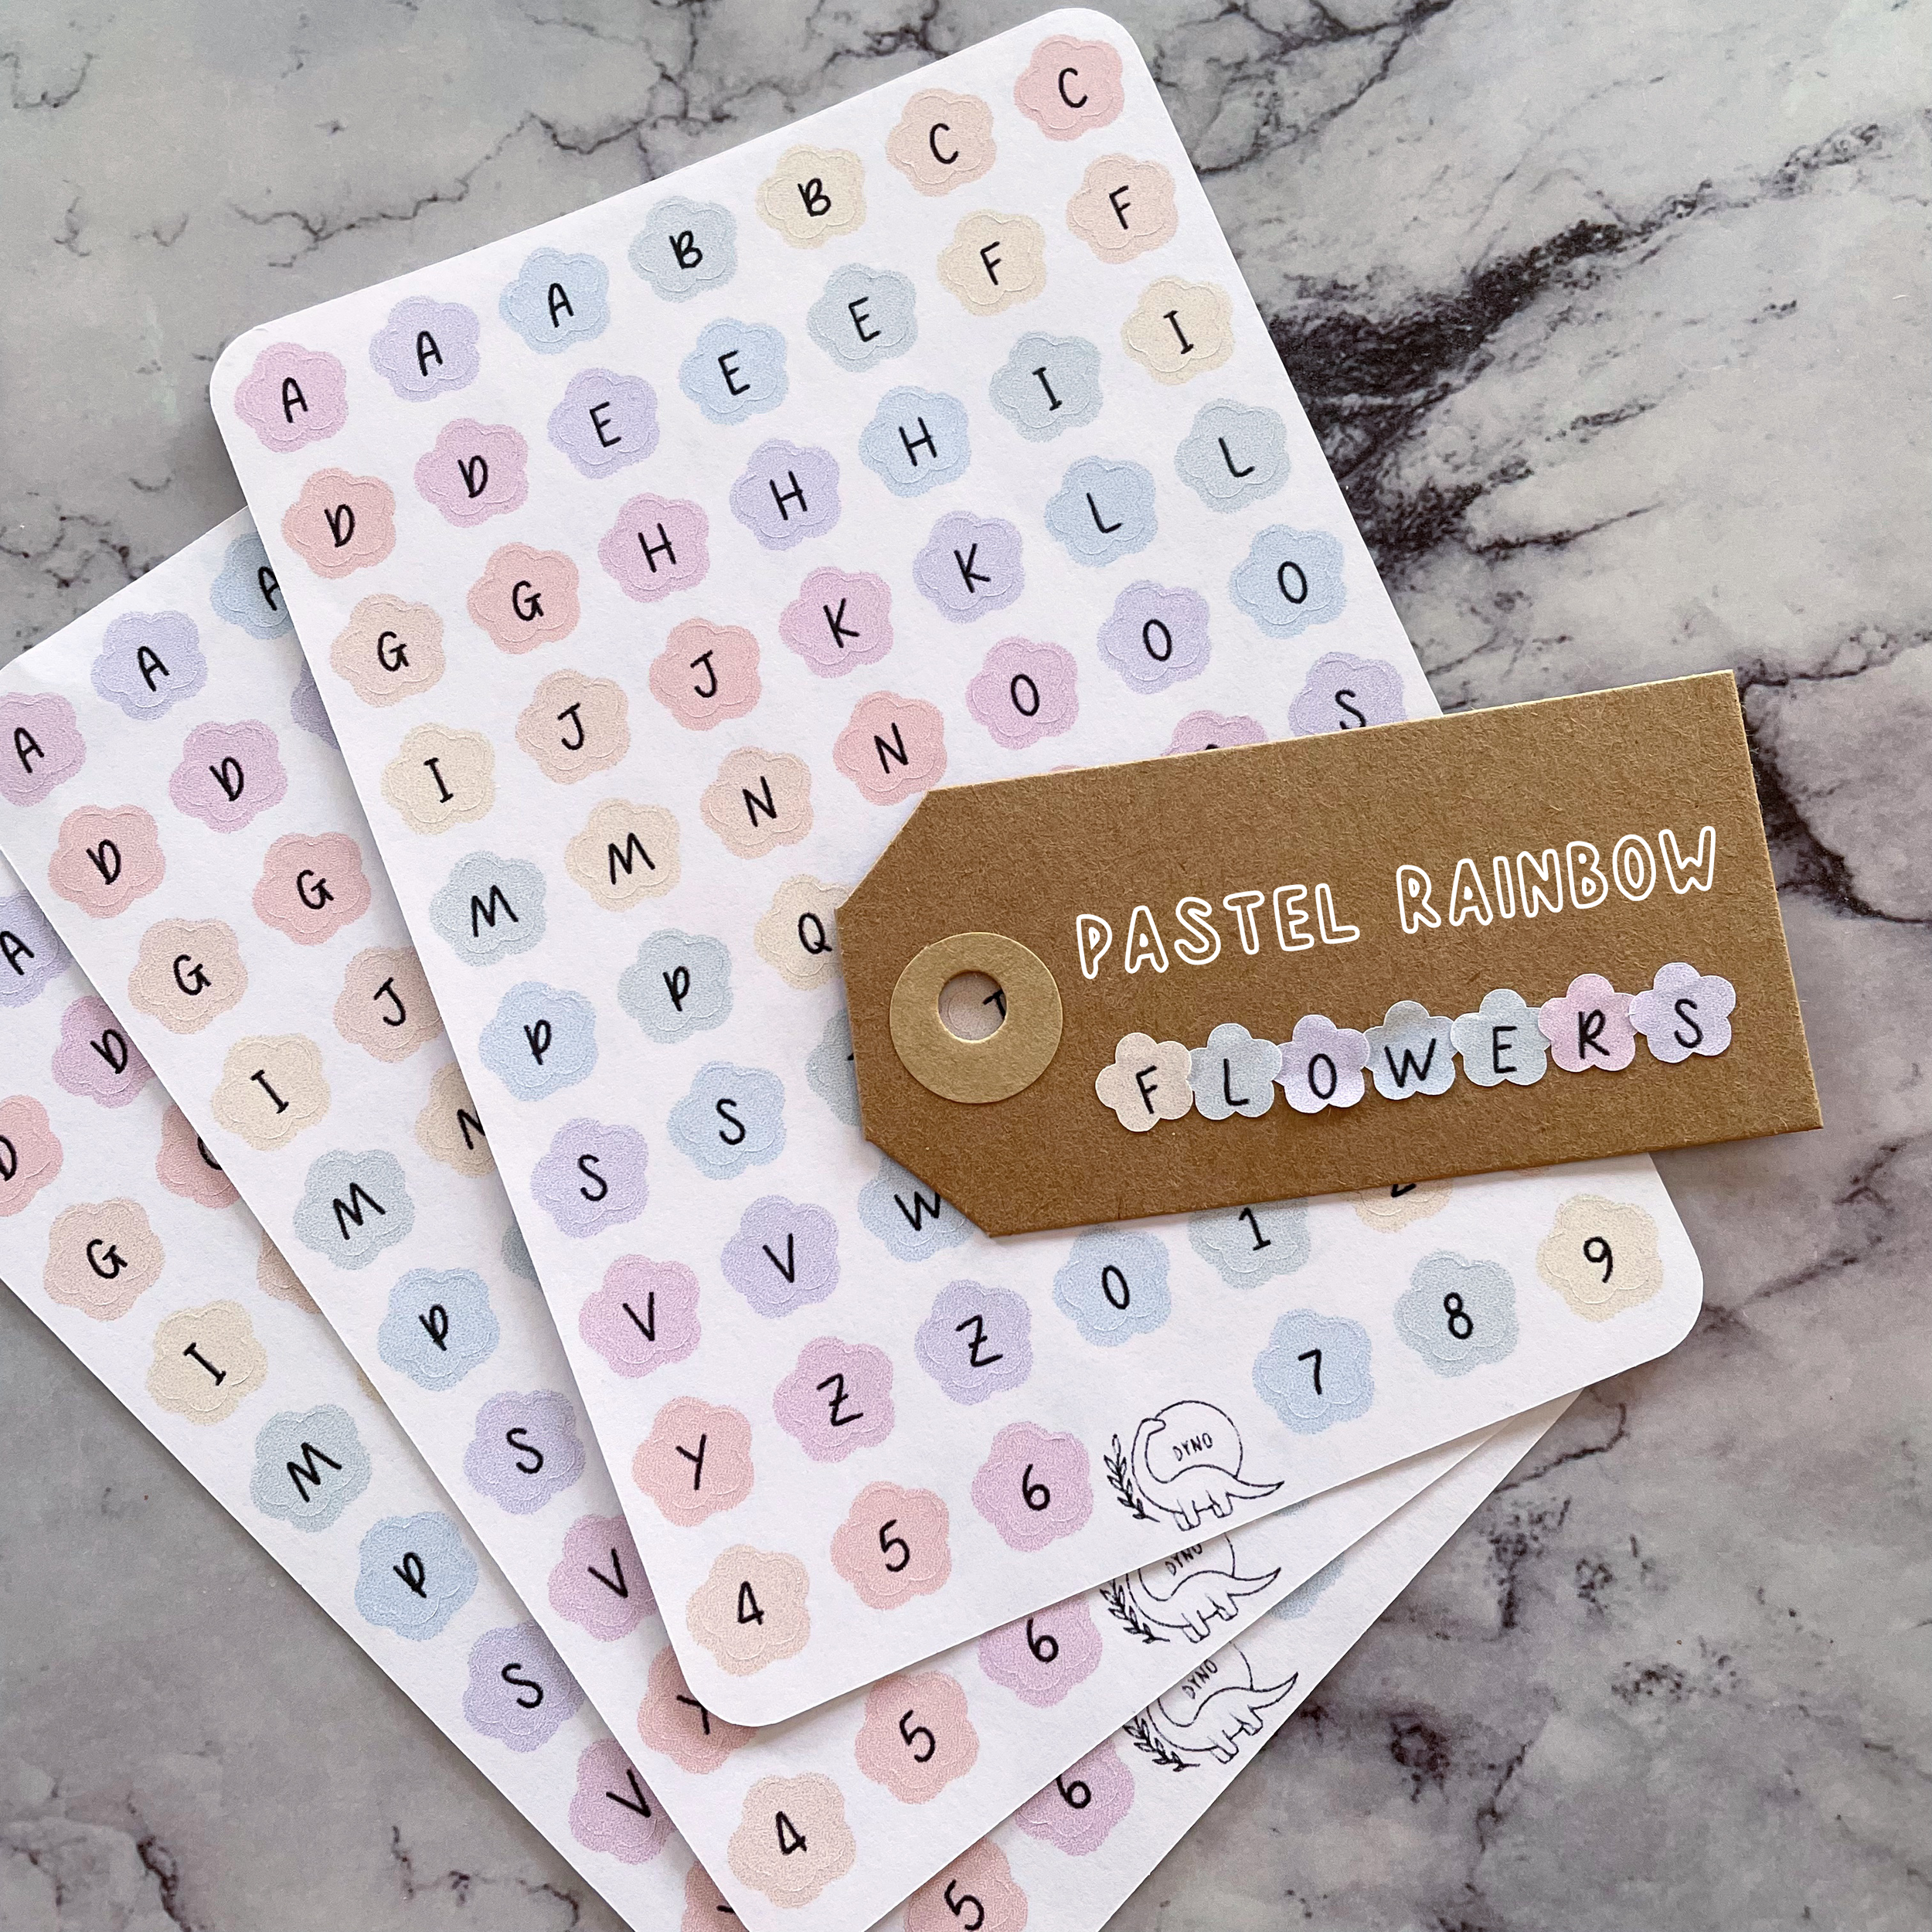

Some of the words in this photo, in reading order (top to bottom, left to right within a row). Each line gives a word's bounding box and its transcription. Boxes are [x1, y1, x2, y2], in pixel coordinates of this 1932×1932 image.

[281, 376, 309, 424] A
[415, 330, 444, 378] A
[546, 281, 575, 329] A
[668, 230, 704, 270] B
[796, 177, 832, 218] B
[928, 122, 960, 165] C
[1057, 66, 1089, 110] C
[323, 502, 356, 549] D
[456, 454, 489, 499] D
[588, 400, 623, 449] E
[716, 349, 751, 397] E
[847, 295, 882, 343] E
[979, 240, 1002, 287] F
[1108, 185, 1131, 231] F
[376, 630, 410, 673] G
[511, 579, 545, 623] G
[637, 522, 677, 574] H
[768, 470, 808, 522] H
[897, 416, 938, 468] H
[1031, 366, 1063, 412] I
[1162, 309, 1195, 355] I
[423, 756, 455, 804] I
[556, 701, 586, 752] J
[689, 648, 719, 699] J
[821, 597, 861, 649] K
[952, 542, 992, 594] K
[1085, 492, 1123, 535] L
[1217, 436, 1256, 479] L
[12, 726, 46, 774] A
[136, 645, 172, 693] A
[470, 883, 520, 939] M
[607, 832, 657, 886] M
[741, 775, 778, 828] N
[872, 721, 910, 775] N
[1009, 672, 1041, 718] O
[1141, 617, 1173, 663] O
[1276, 560, 1309, 605] O
[85, 838, 122, 886] D
[208, 755, 245, 803] D
[522, 1019, 553, 1066] P
[662, 964, 692, 1013] P
[796, 911, 834, 956] Q
[1334, 688, 1368, 729] S
[0, 930, 36, 977] A
[172, 953, 213, 997] G
[295, 869, 335, 911] G
[1077, 883, 1359, 979] PASTEL
[1396, 826, 1716, 934] RAINBOW
[89, 1027, 130, 1076] D
[249, 1068, 290, 1115] I
[372, 976, 407, 1028] J
[1134, 997, 1705, 1115] FLOWERS
[577, 1153, 609, 1202] S
[715, 1097, 747, 1147] S
[85, 1237, 129, 1281] G
[332, 1181, 387, 1241] M
[621, 1291, 656, 1342] V
[761, 1232, 796, 1284] V
[893, 1190, 941, 1232] W
[182, 1341, 227, 1387] I
[417, 1303, 450, 1352] P
[1297, 1347, 1323, 1396] 7
[1442, 1291, 1475, 1341] 8
[1582, 1235, 1614, 1284] 9
[505, 1427, 545, 1476] S
[675, 1433, 708, 1492] Y
[815, 1372, 865, 1427] Z
[954, 1314, 1005, 1369] Z
[1172, 1431, 1214, 1462] DYNO
[285, 1440, 343, 1504] M
[392, 1551, 428, 1600] P
[587, 1546, 630, 1600] V
[736, 1580, 766, 1627] 4
[878, 1518, 911, 1573] 5
[1021, 1463, 1052, 1512] 6
[500, 1662, 545, 1710] S
[774, 1810, 808, 1856] 4
[898, 1709, 937, 1764] 5
[1026, 1617, 1060, 1664] 6
[1181, 1658, 1219, 1700] DYNO
[605, 1768, 652, 1818] V
[943, 1878, 986, 1932] 5
